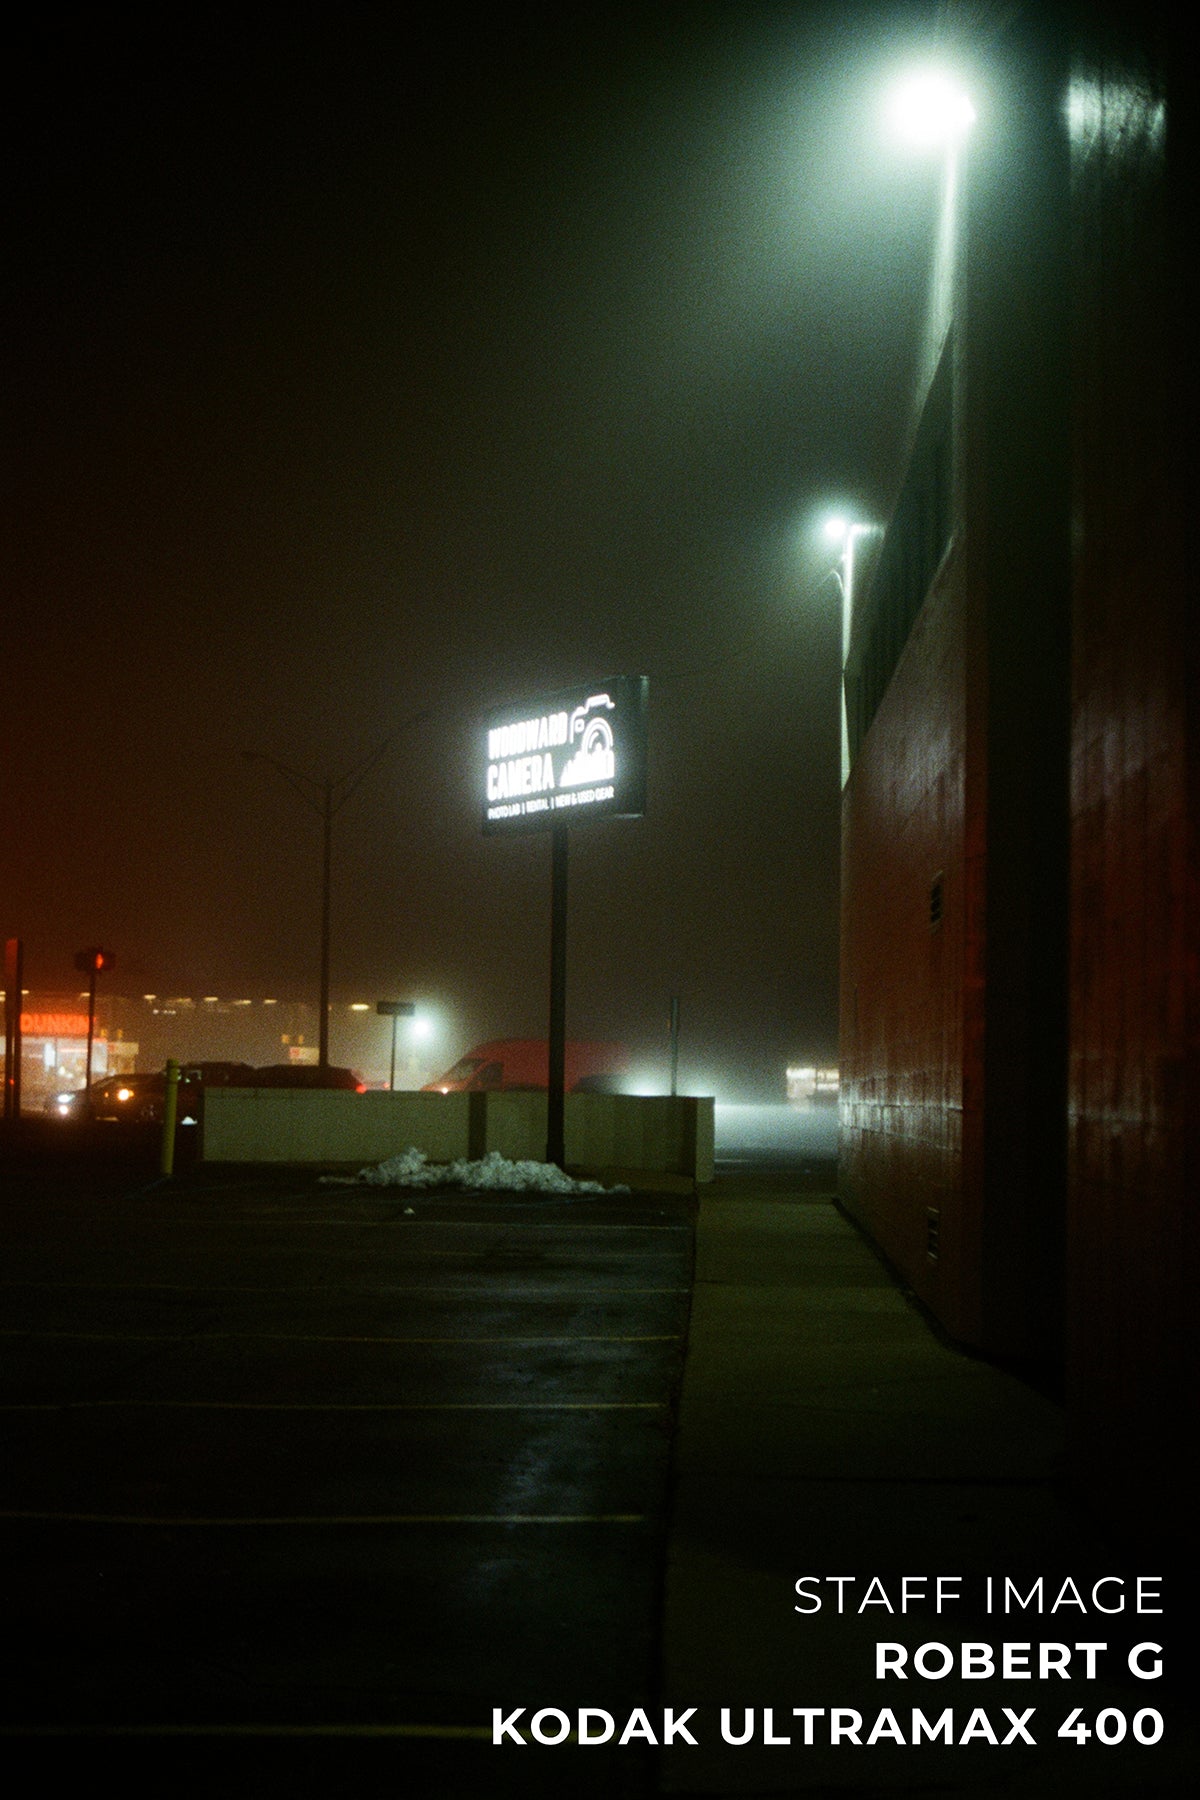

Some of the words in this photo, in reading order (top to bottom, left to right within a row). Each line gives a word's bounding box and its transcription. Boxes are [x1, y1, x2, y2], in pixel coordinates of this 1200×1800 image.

[488, 711, 568, 760] WOODWARD
[487, 752, 555, 801] CAMERA
[555, 794, 571, 807] NEW
